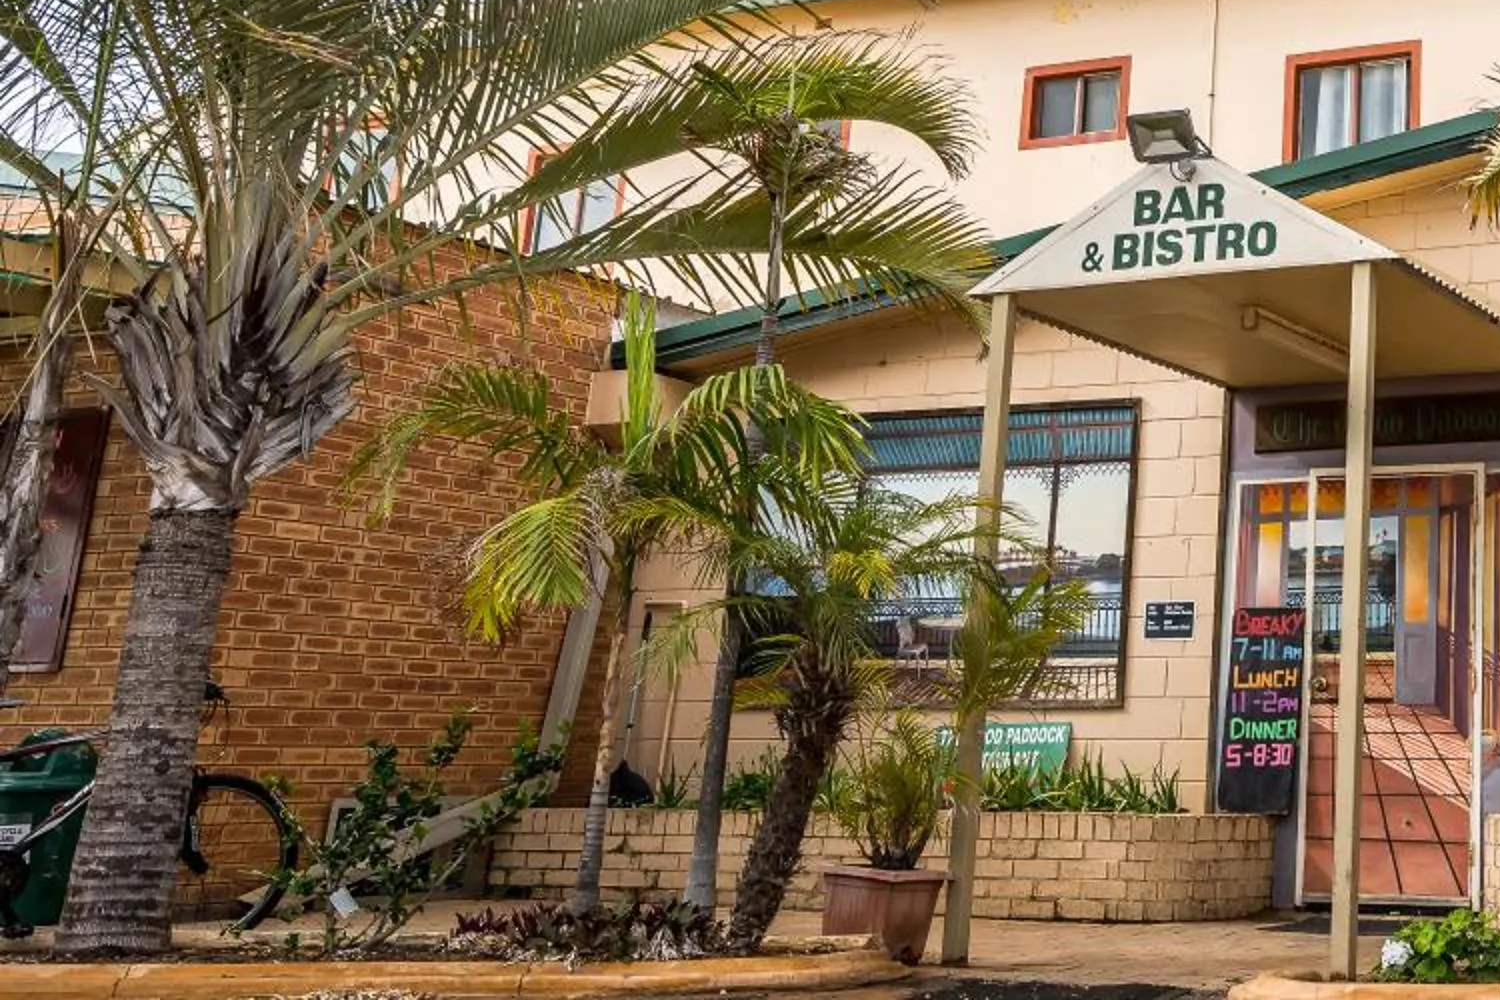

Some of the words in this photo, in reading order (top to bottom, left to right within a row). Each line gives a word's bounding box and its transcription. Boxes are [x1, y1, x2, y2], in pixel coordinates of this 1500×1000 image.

[1133, 183, 1226, 227] BAR
[1081, 241, 1105, 272] &
[1111, 221, 1277, 271] BISTRO
[1232, 637, 1275, 661] 7-11
[1233, 664, 1297, 689] LUNCH
[1005, 725, 1067, 745] PADDOCK
[1230, 717, 1297, 740] DINNER
